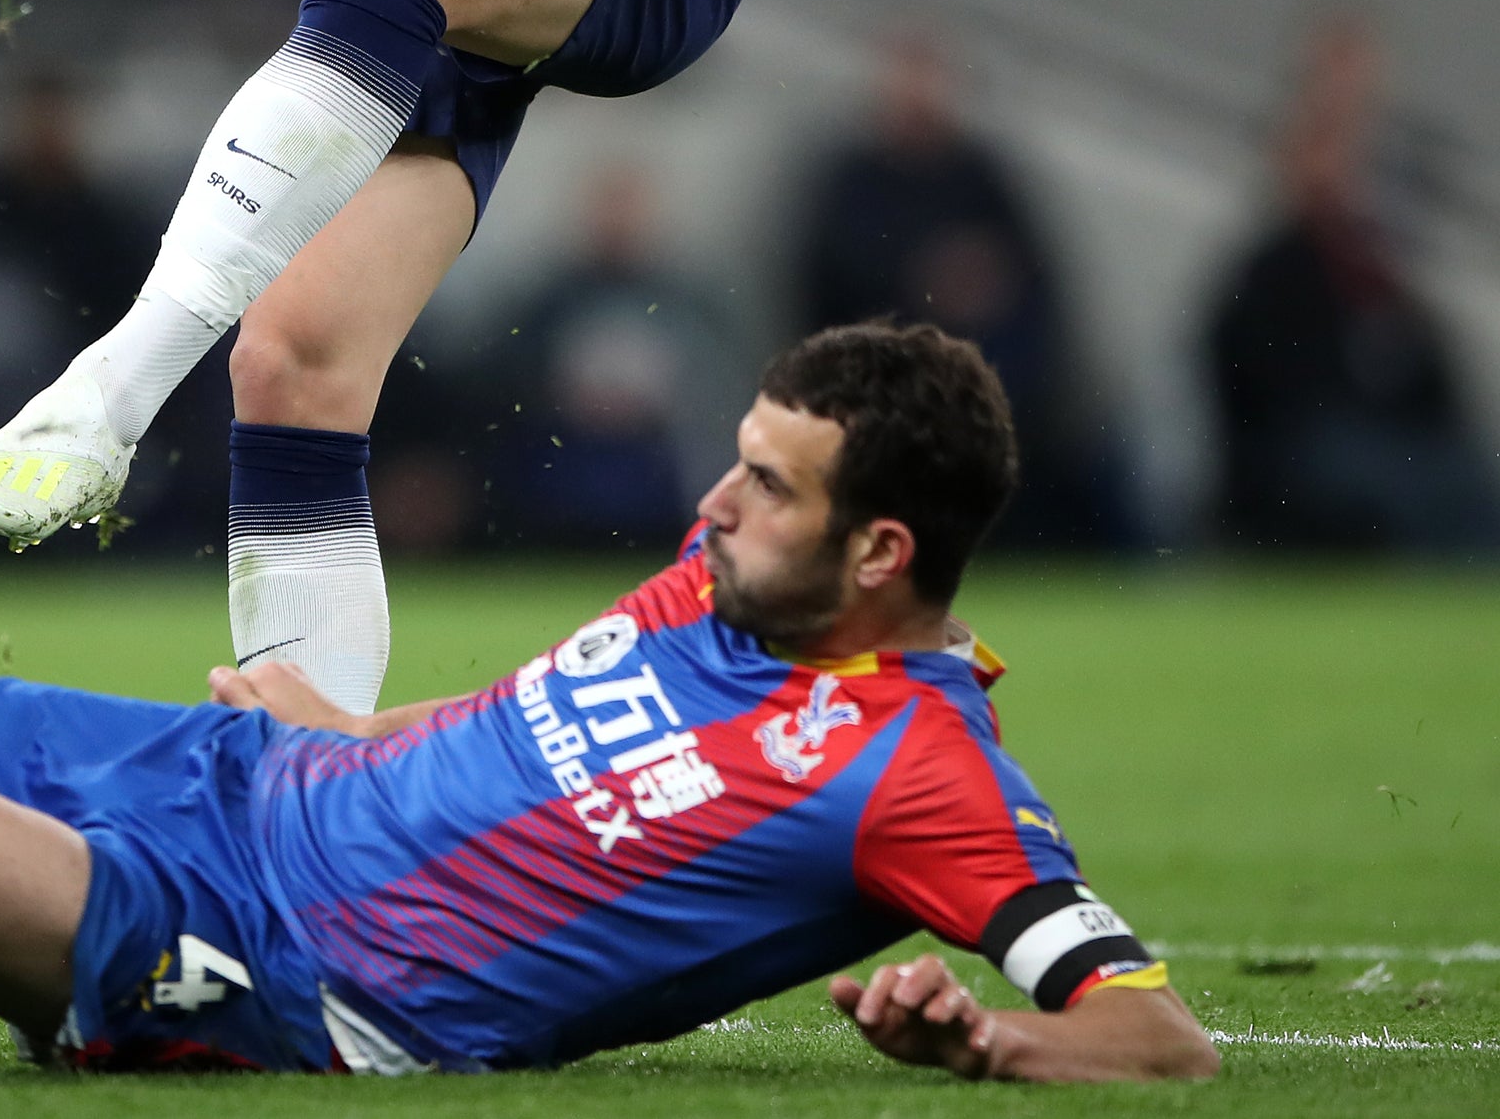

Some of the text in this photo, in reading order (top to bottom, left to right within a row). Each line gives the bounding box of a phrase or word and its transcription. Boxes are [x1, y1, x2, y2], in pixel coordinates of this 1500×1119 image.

[207, 171, 261, 214] SPURS
[570, 662, 727, 820] 万博
[153, 933, 254, 1012] 4
